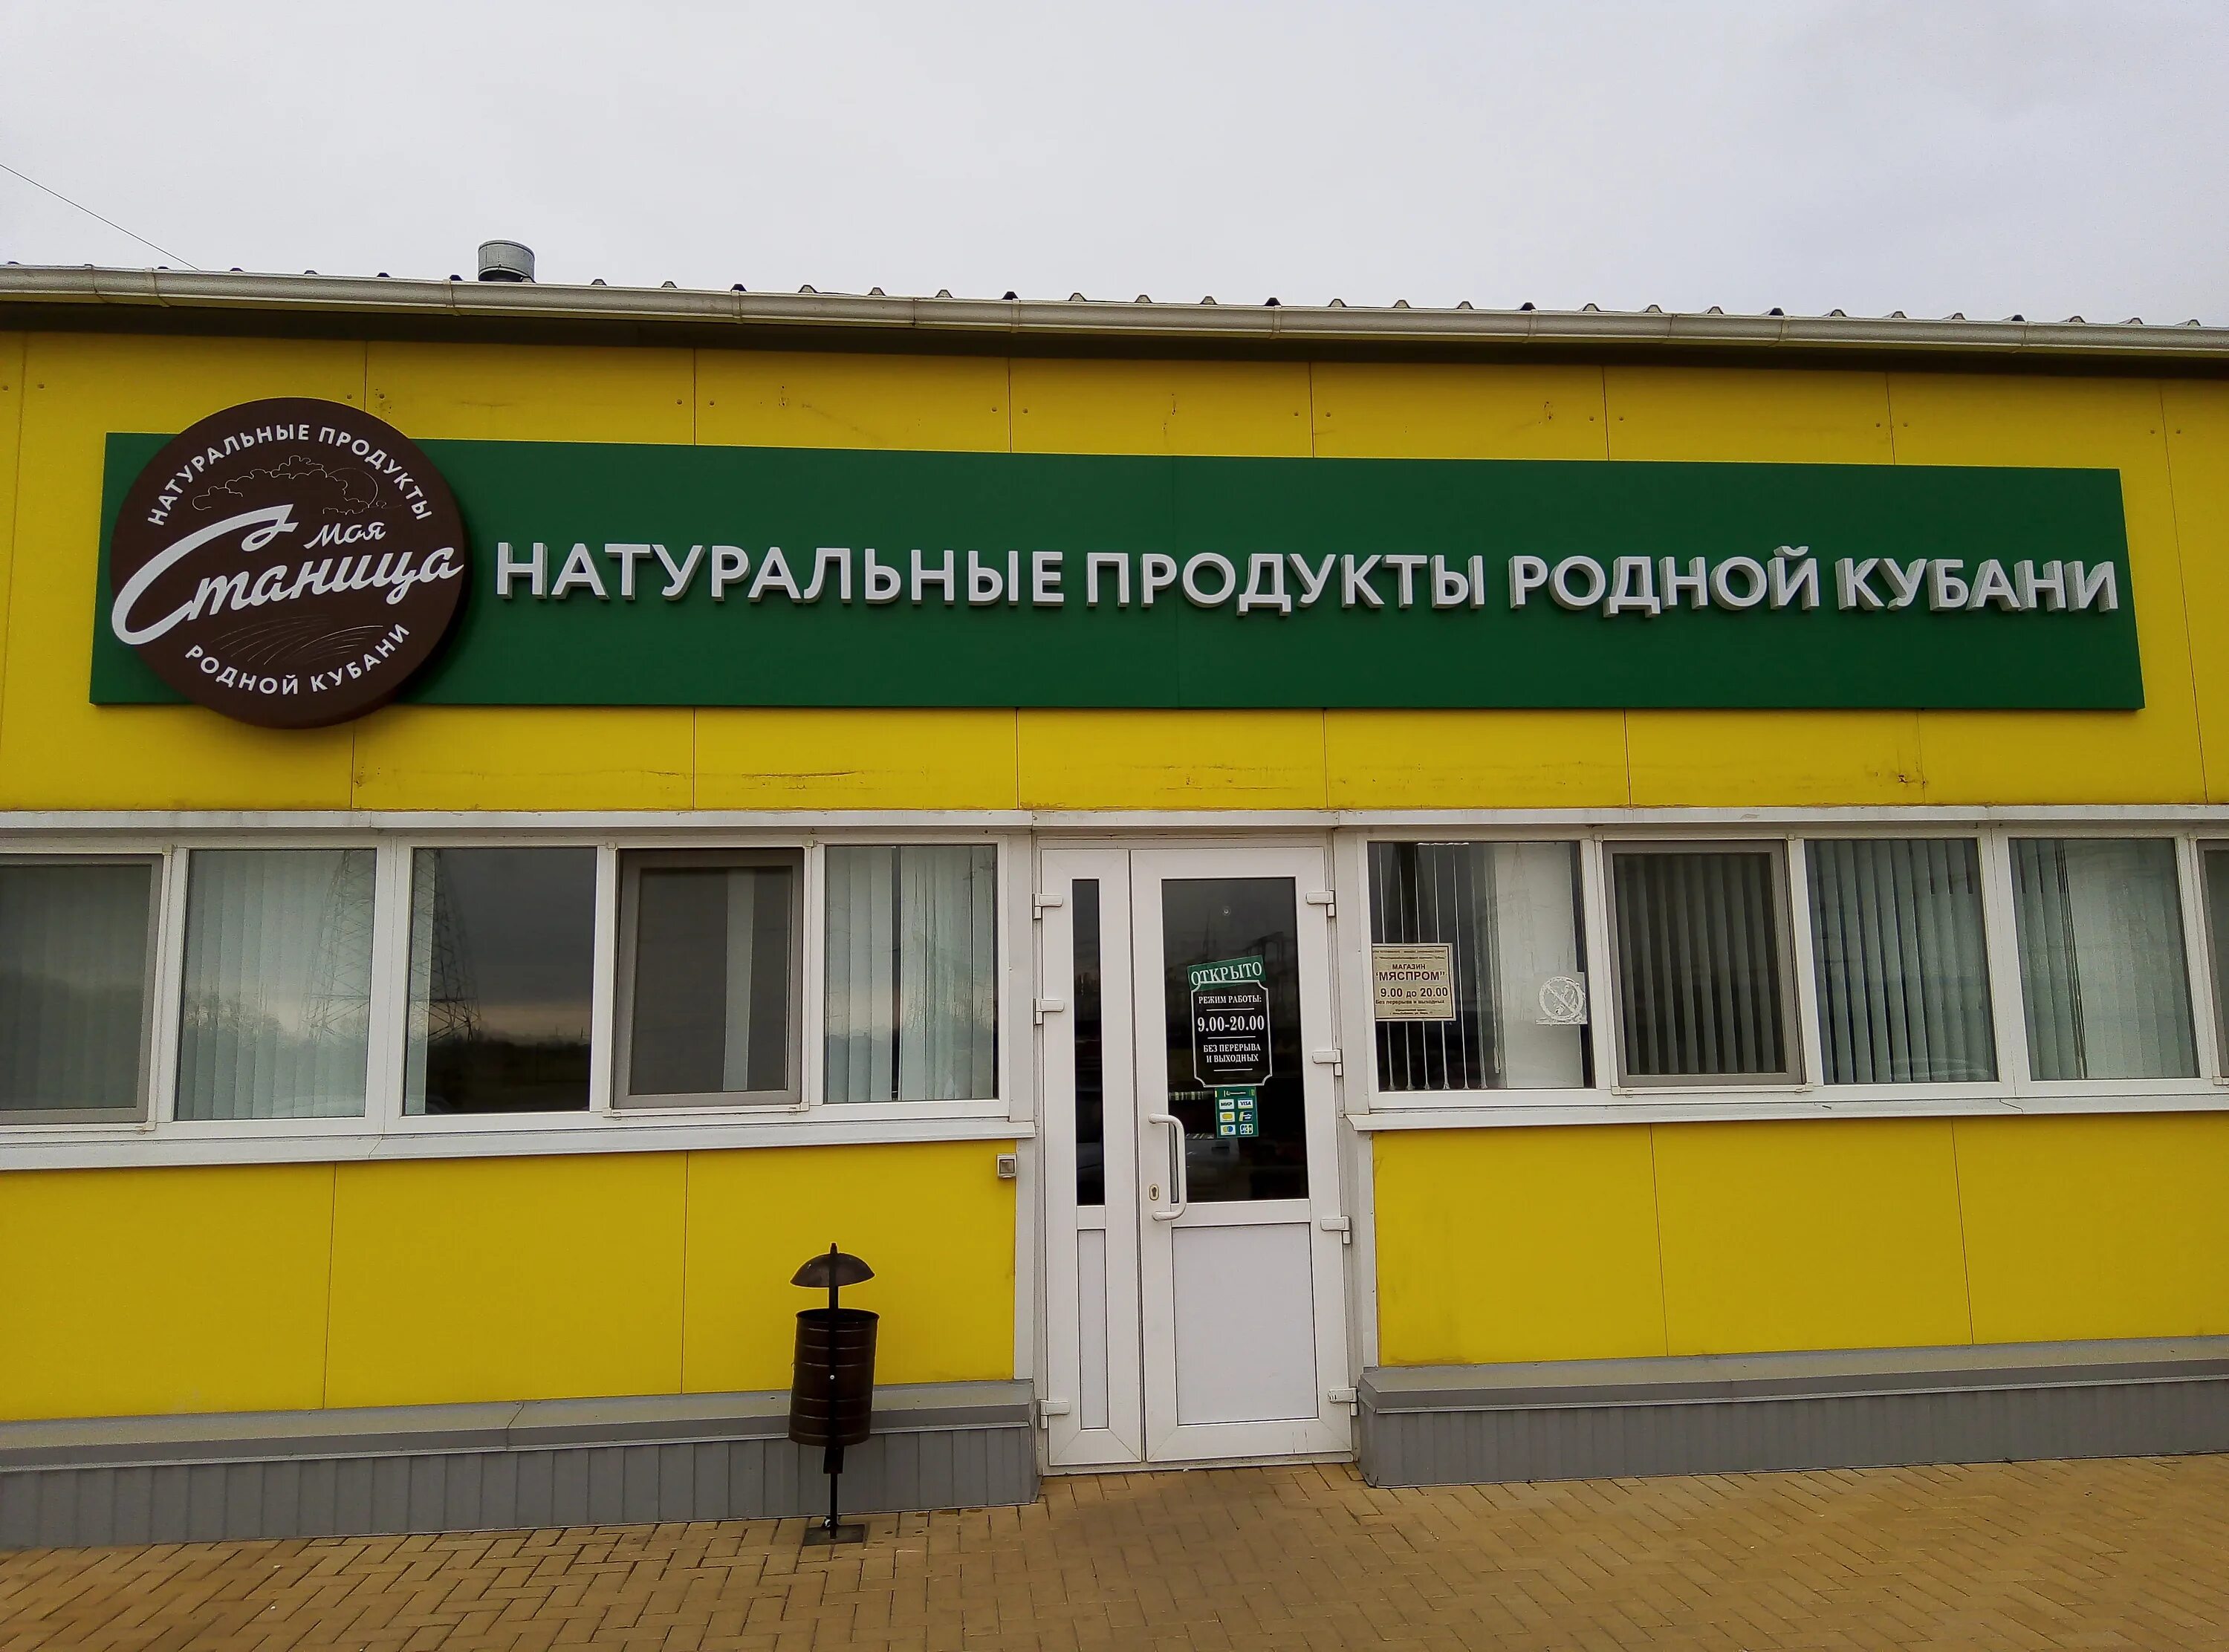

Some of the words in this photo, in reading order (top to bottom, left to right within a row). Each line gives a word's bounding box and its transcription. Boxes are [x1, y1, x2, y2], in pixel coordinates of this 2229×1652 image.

[148, 423, 310, 525] НАТУРАЛЬНЫЕ
[318, 426, 432, 521] ПРОДУКТЫ
[111, 504, 464, 645] Станица
[496, 542, 1065, 606] НАТУРАЛЬНЫЕ
[1086, 552, 1485, 617] ПРОДУКТЫ
[1508, 545, 1820, 618] РОДНОЙ
[1834, 558, 2120, 614] КУБАНИ
[185, 645, 298, 695] РОДНОЙ
[311, 623, 410, 692] КУБАНИ
[1190, 960, 1263, 986] ОТКРЫТО
[1198, 995, 1227, 1004] РЕЖИМ
[1228, 994, 1262, 1004] РАБОТЫ:
[1380, 987, 1403, 998] 9.00
[1406, 990, 1417, 998] до
[1420, 986, 1448, 997] 20.00
[1197, 1015, 1265, 1032] 9.00-20.00
[1203, 1044, 1218, 1053] БЕЗ
[1219, 1043, 1261, 1052] ПЕРЕРЫВА
[1206, 1054, 1212, 1063] И
[1213, 1053, 1259, 1063] ВЫХОДНЫХ
